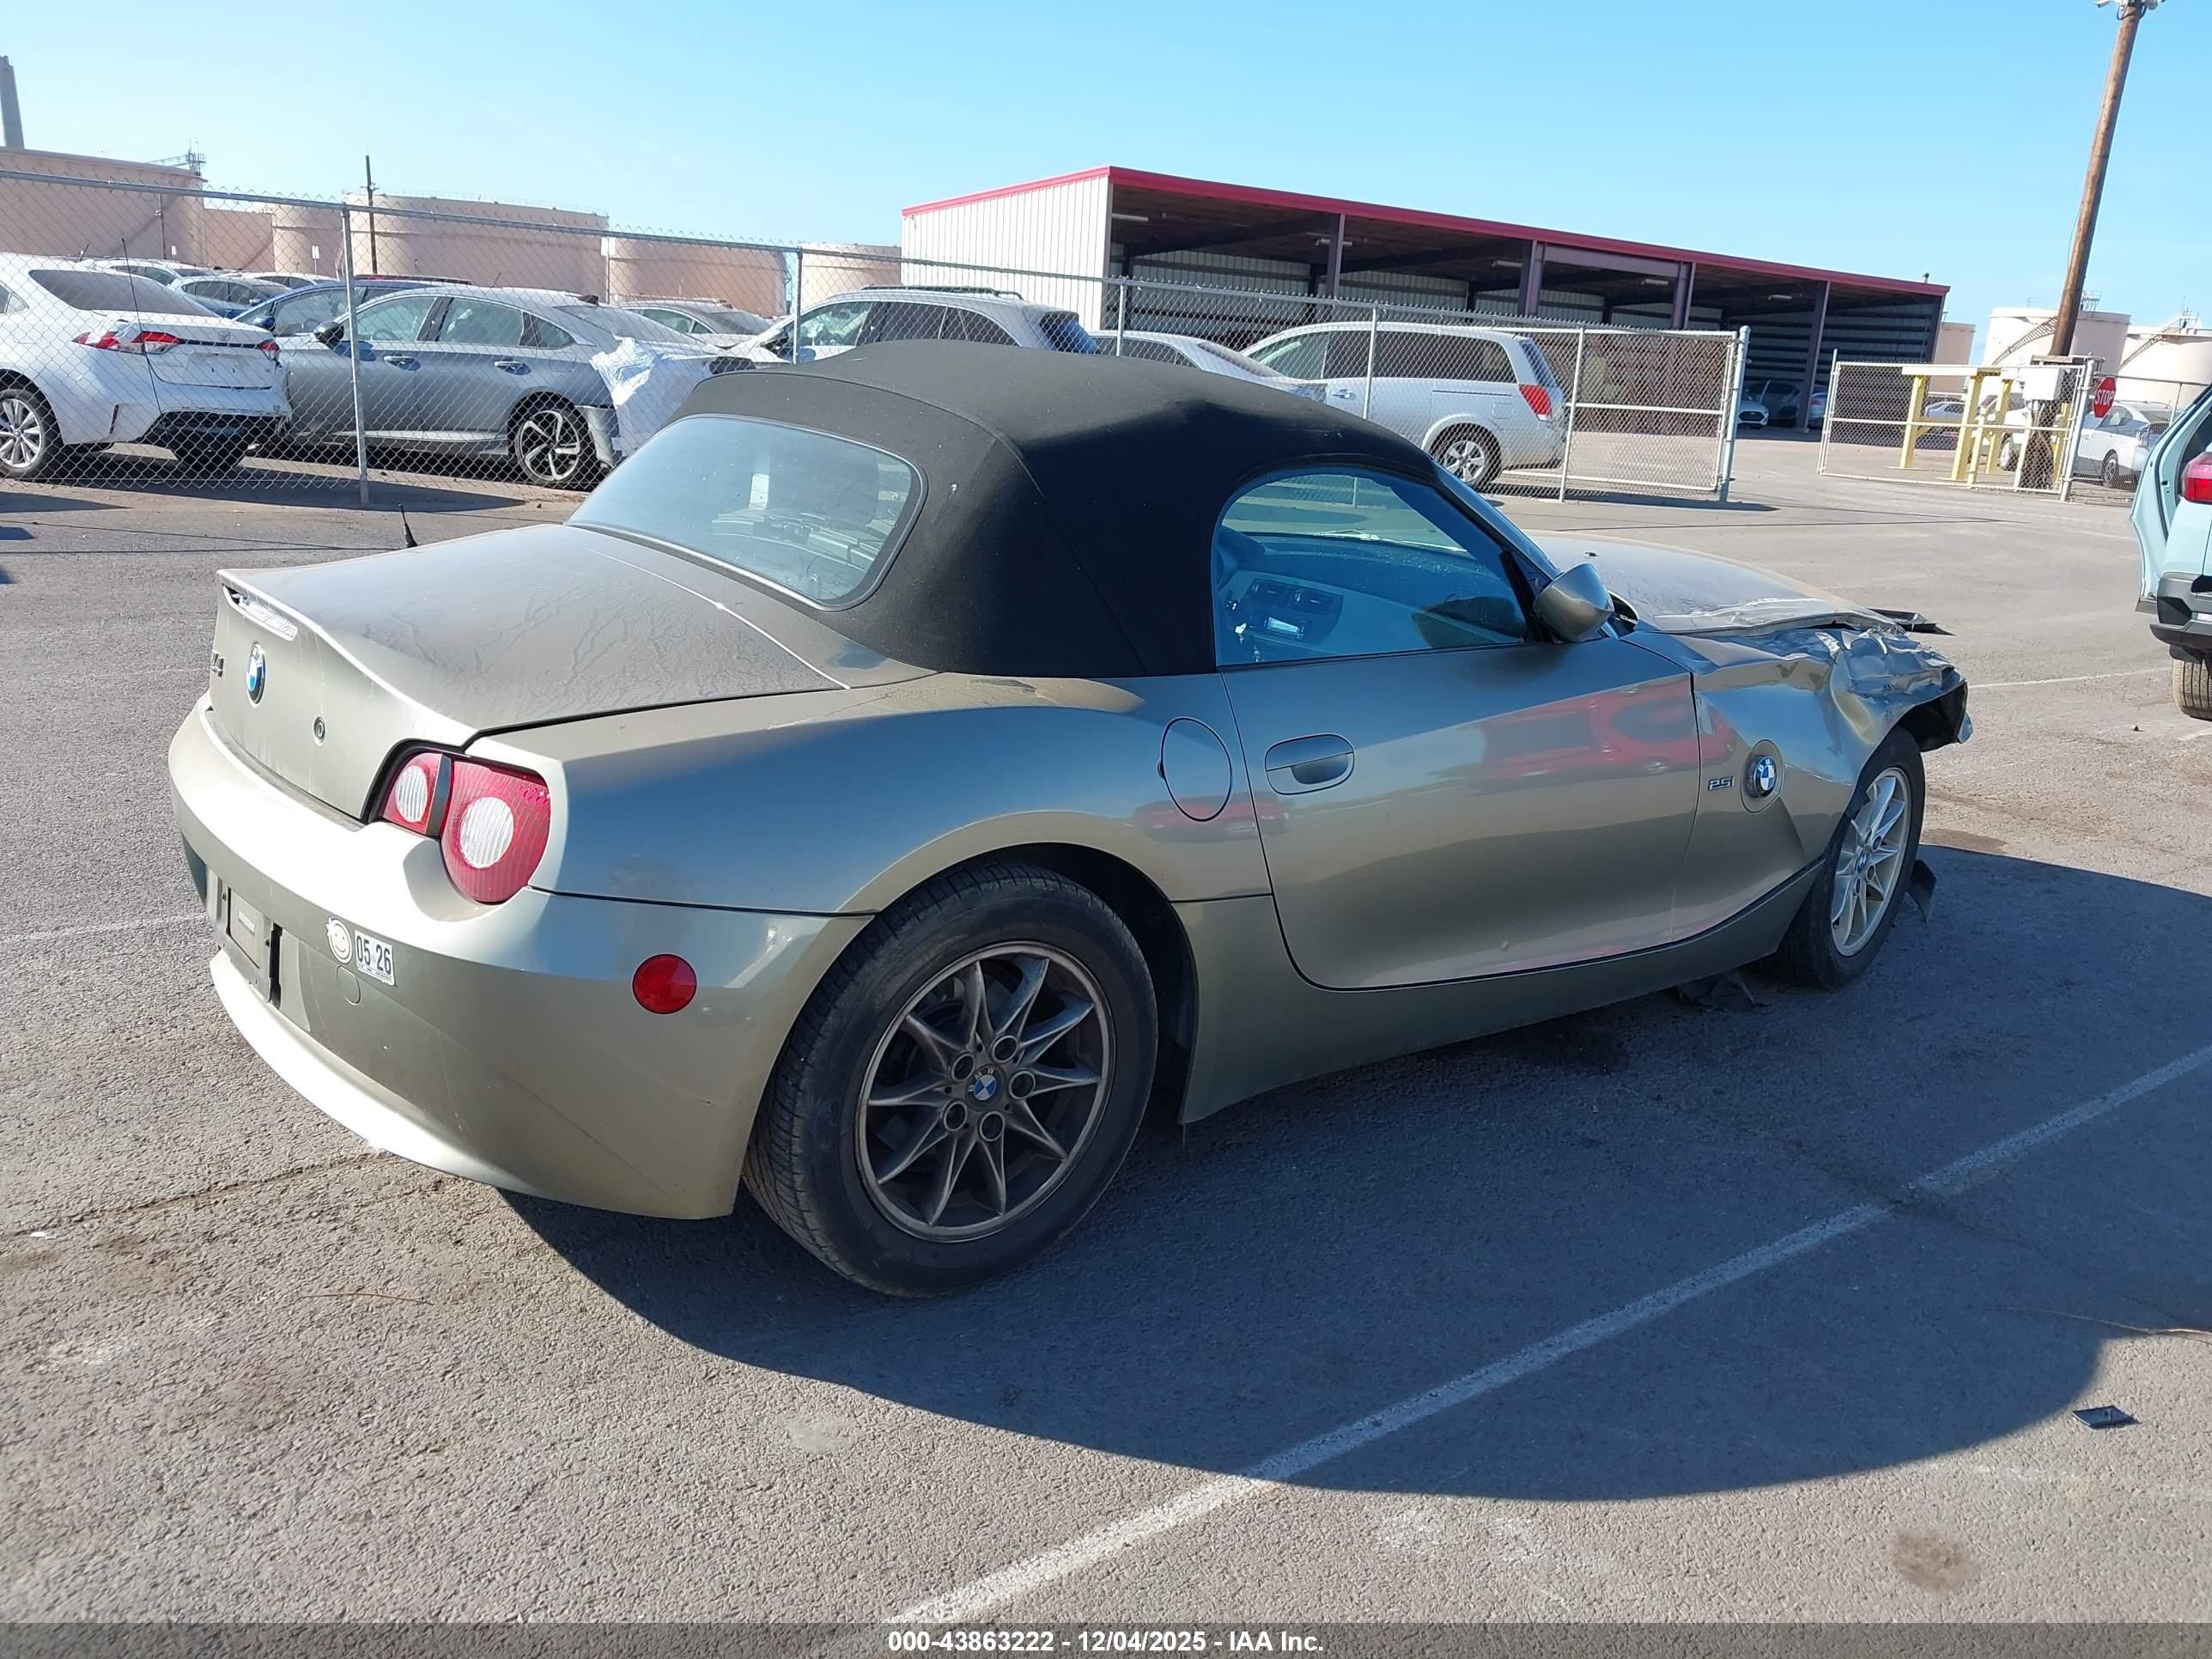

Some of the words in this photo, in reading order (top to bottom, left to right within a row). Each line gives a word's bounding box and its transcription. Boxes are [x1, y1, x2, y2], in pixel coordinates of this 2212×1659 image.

[2095, 389, 2114, 405] STOP
[356, 935, 370, 965] 05
[376, 945, 392, 975] 26
[968, 1066, 995, 1092] BMW
